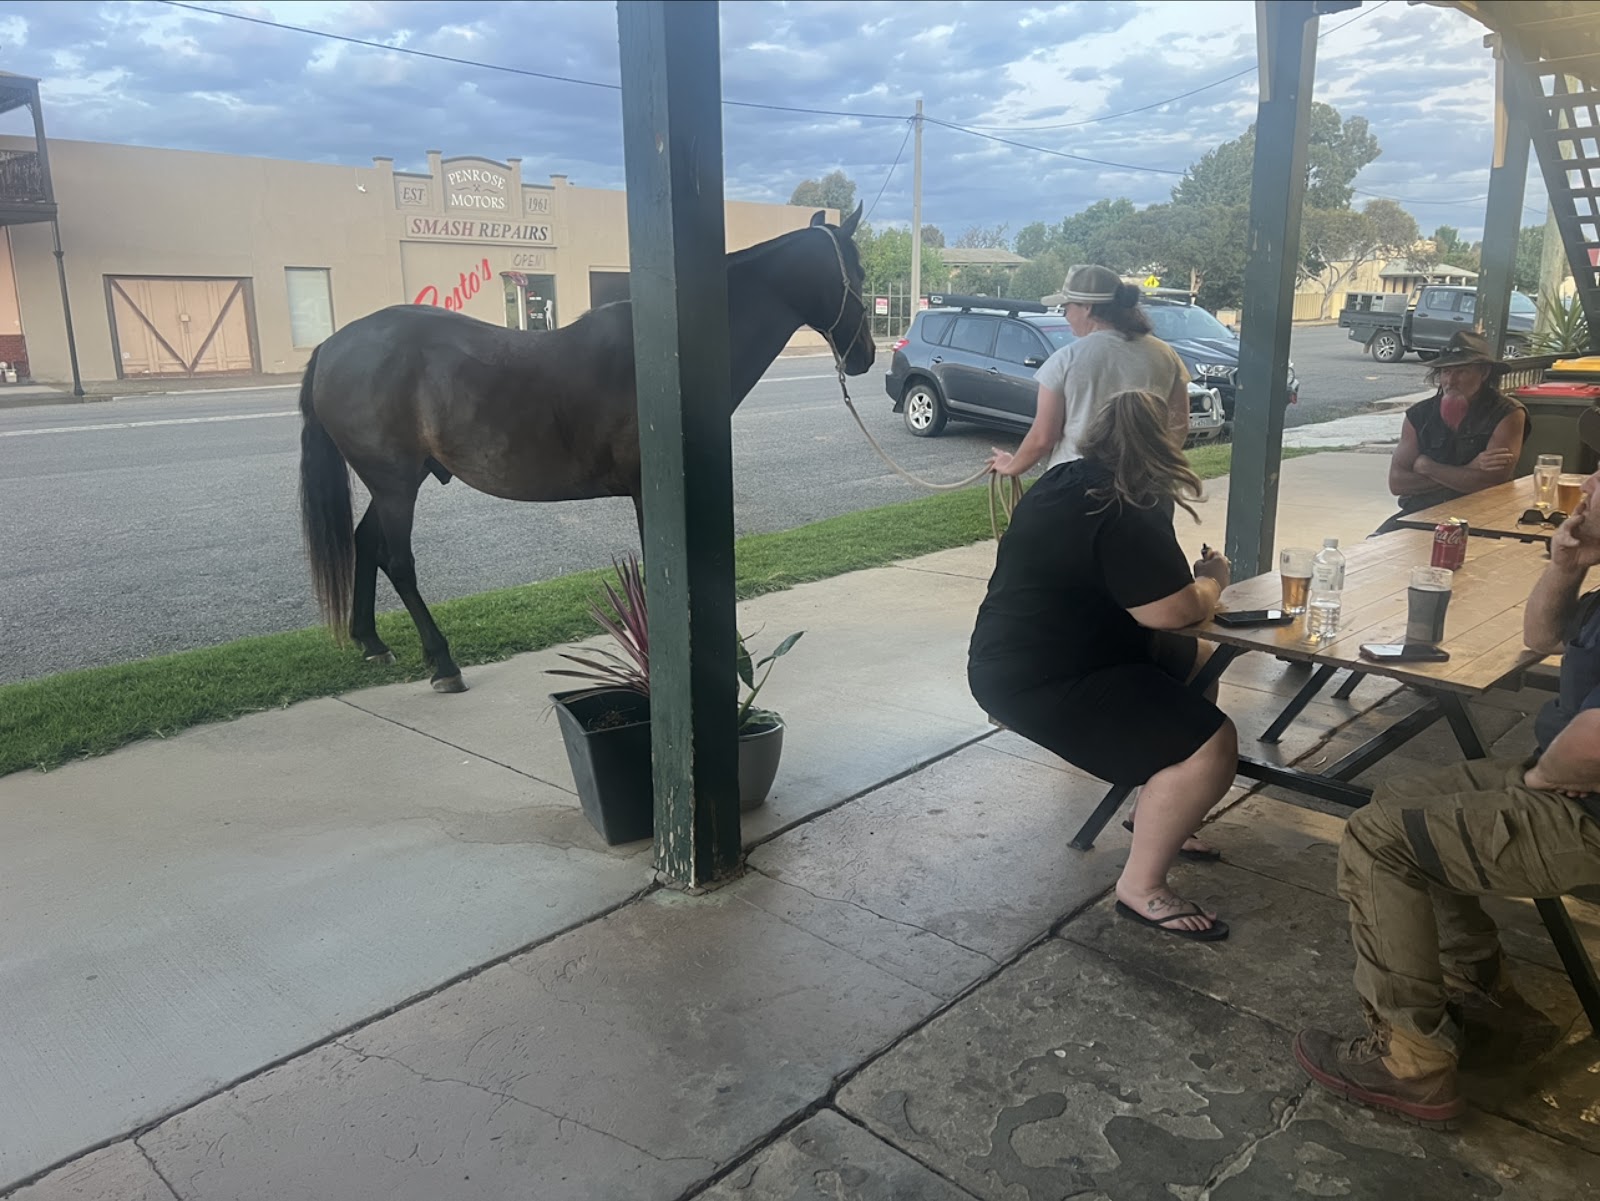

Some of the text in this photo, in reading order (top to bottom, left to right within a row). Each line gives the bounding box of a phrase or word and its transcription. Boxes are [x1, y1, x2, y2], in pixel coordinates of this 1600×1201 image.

[448, 169, 506, 190] PENROSE
[403, 187, 425, 201] EST
[451, 193, 505, 209] MOTORS
[528, 198, 547, 211] 1961
[411, 218, 548, 241] SMASH REPAIRS
